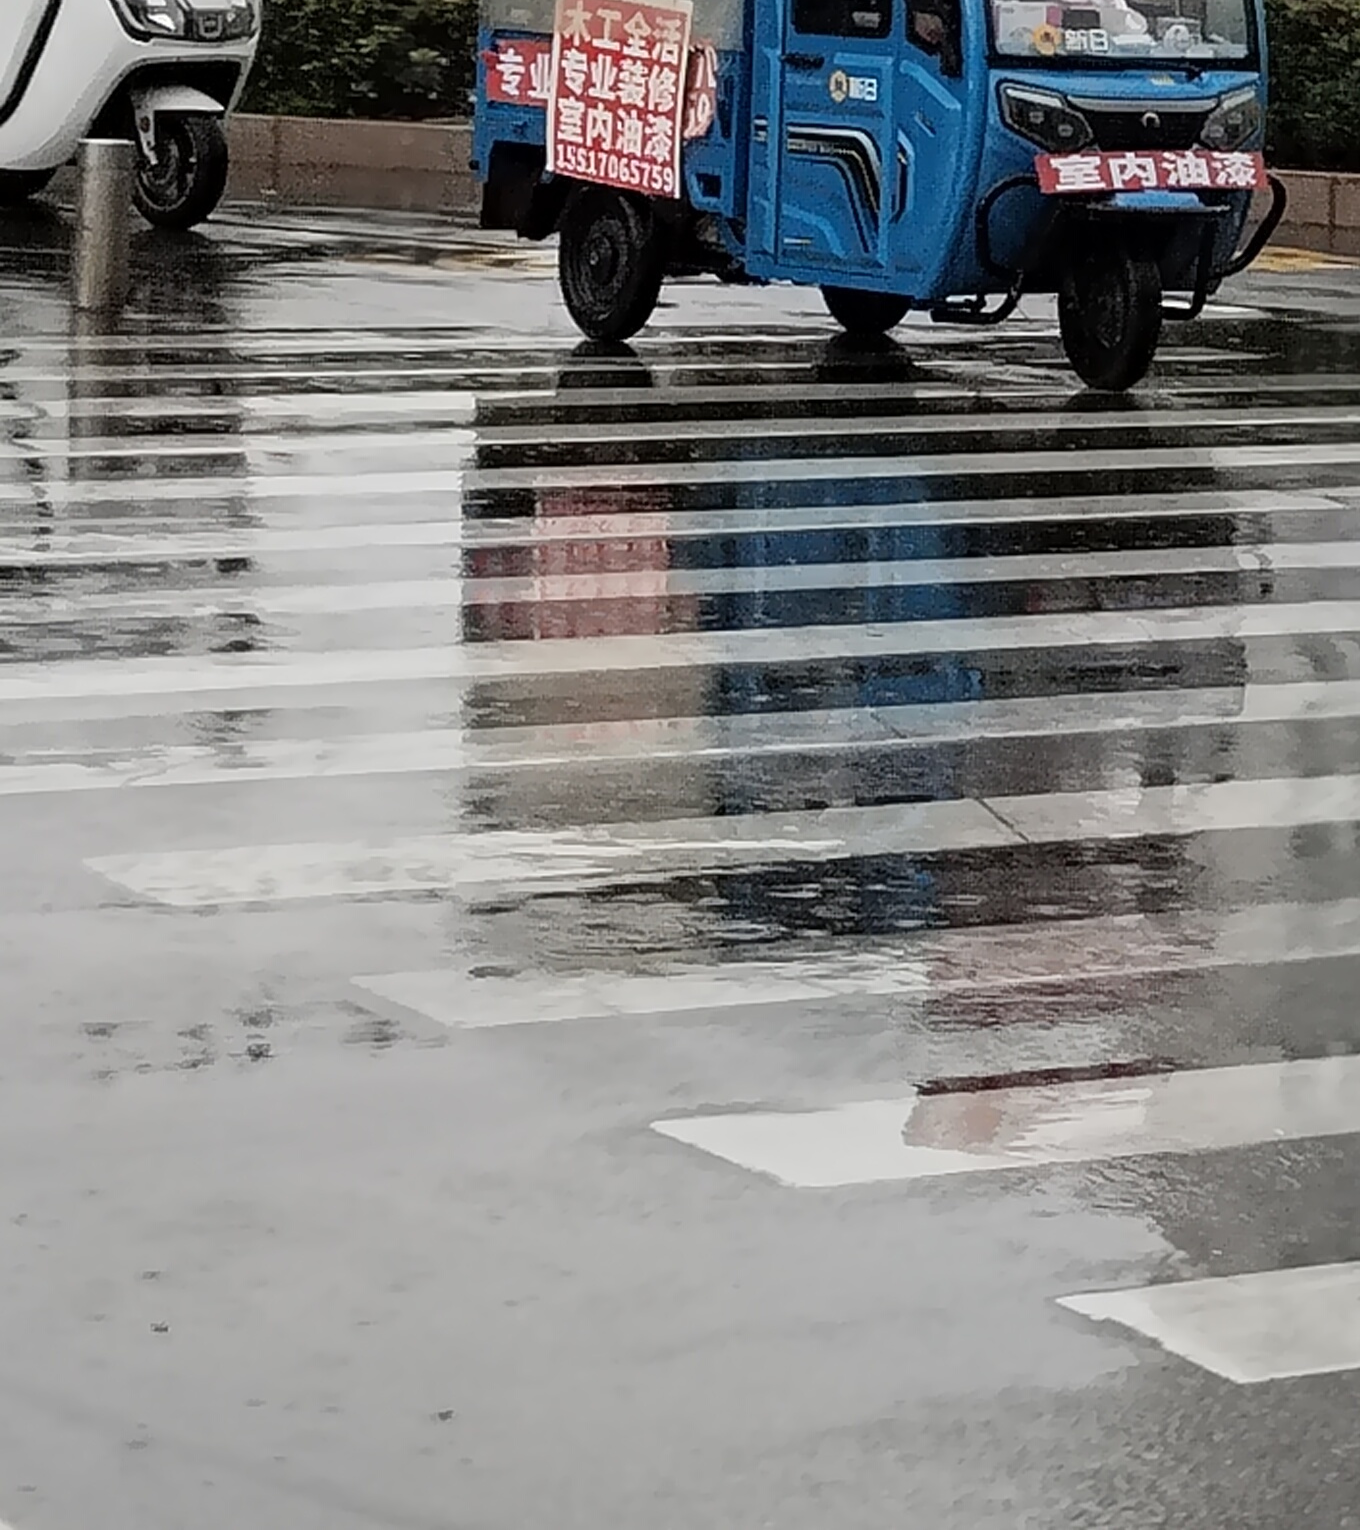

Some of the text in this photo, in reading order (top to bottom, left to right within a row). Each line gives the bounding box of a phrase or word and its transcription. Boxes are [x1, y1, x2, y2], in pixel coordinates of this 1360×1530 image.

[563, 0, 681, 65] 木工全活
[560, 48, 678, 113] 专业装修
[557, 96, 673, 164] 室内油漆
[556, 144, 674, 193] 15517065759
[1050, 152, 1257, 191] 室内油漆
